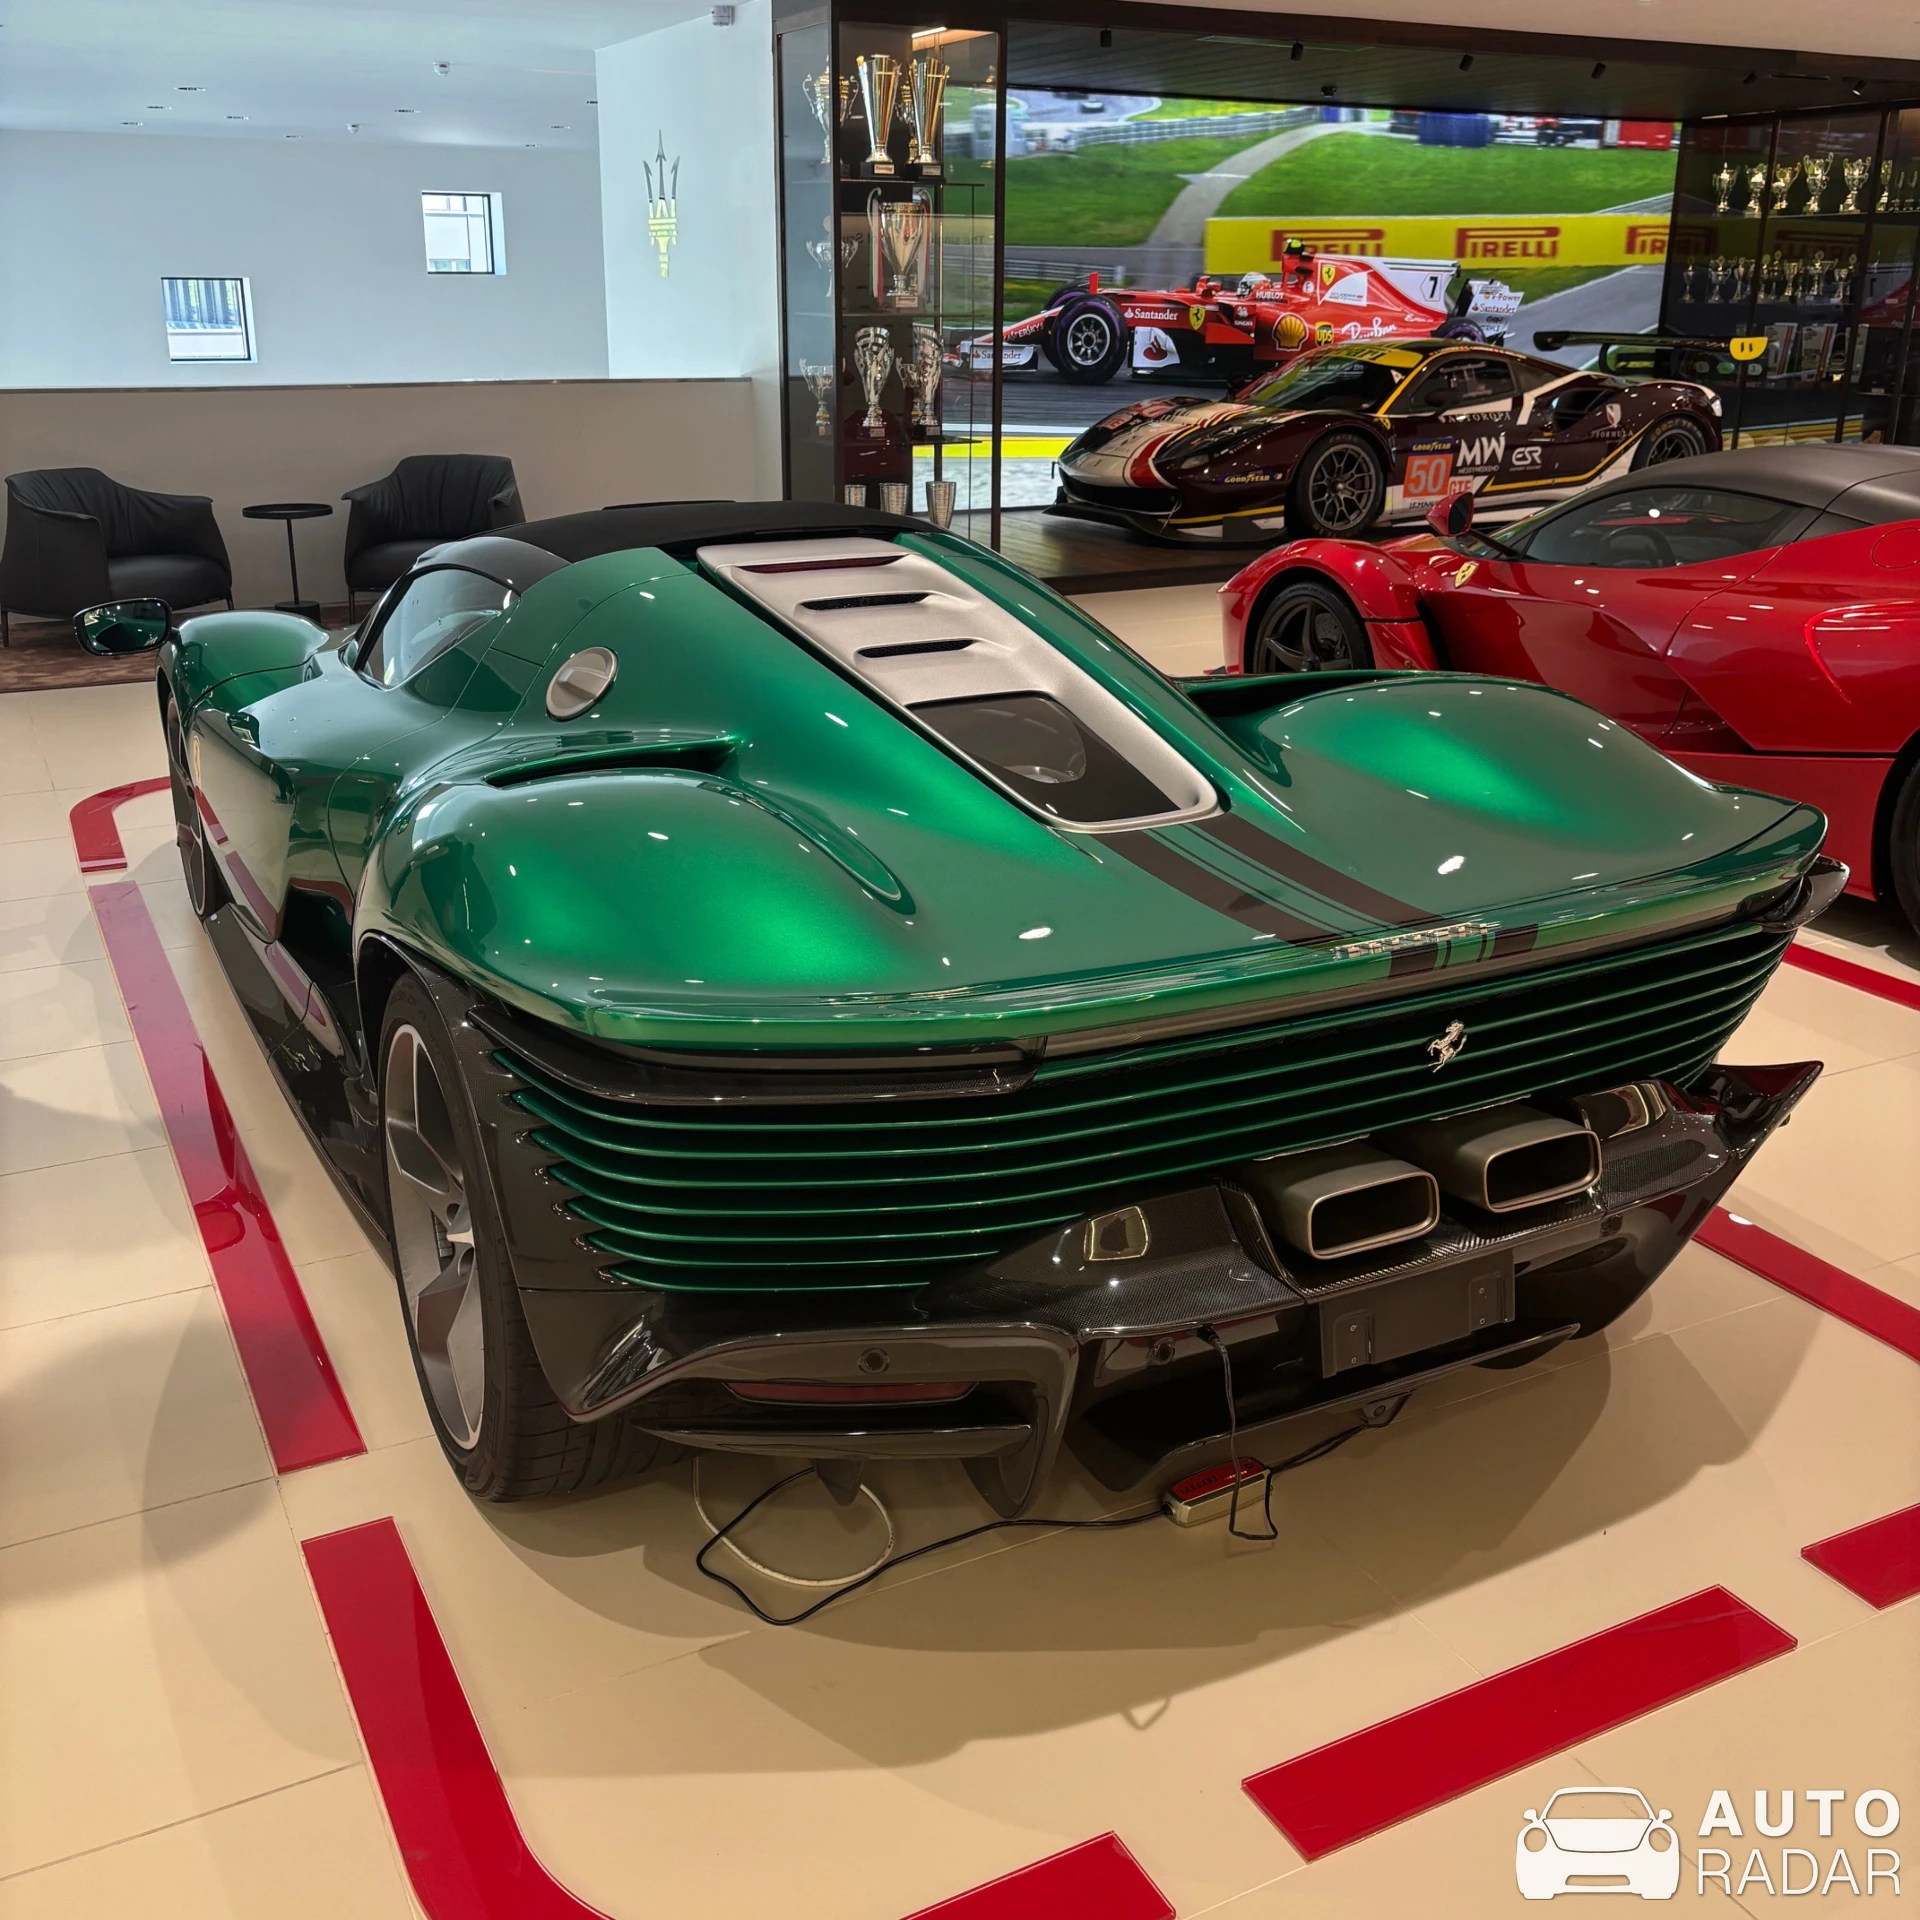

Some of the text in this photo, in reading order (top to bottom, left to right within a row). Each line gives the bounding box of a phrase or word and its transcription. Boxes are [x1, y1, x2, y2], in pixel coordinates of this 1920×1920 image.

[1455, 226, 1559, 259] PIRELLI
[1255, 291, 1284, 300] HUBLOT
[1429, 276, 1438, 299] 7
[1134, 307, 1179, 321] Santander
[1224, 474, 1270, 485] GOODYEAR
[1408, 457, 1446, 494] 50
